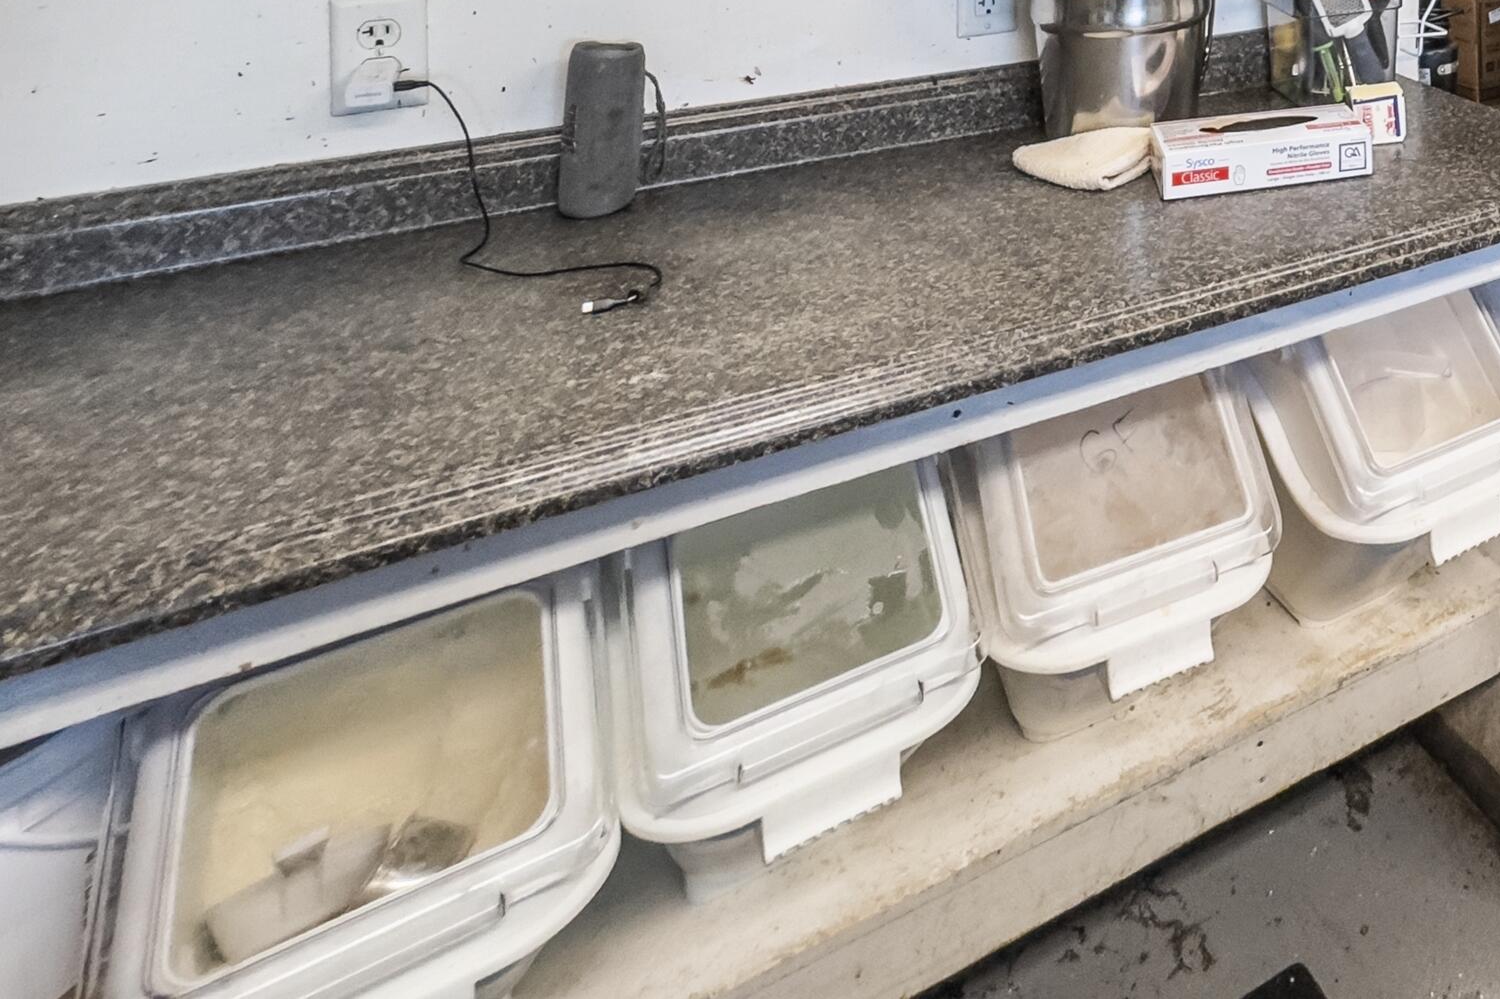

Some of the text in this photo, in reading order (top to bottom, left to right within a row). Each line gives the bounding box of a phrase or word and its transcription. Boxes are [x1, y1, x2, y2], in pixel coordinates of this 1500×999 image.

[1272, 142, 1331, 154] High Performance
[1185, 157, 1216, 168] Sysco
[1181, 170, 1220, 185] Classic
